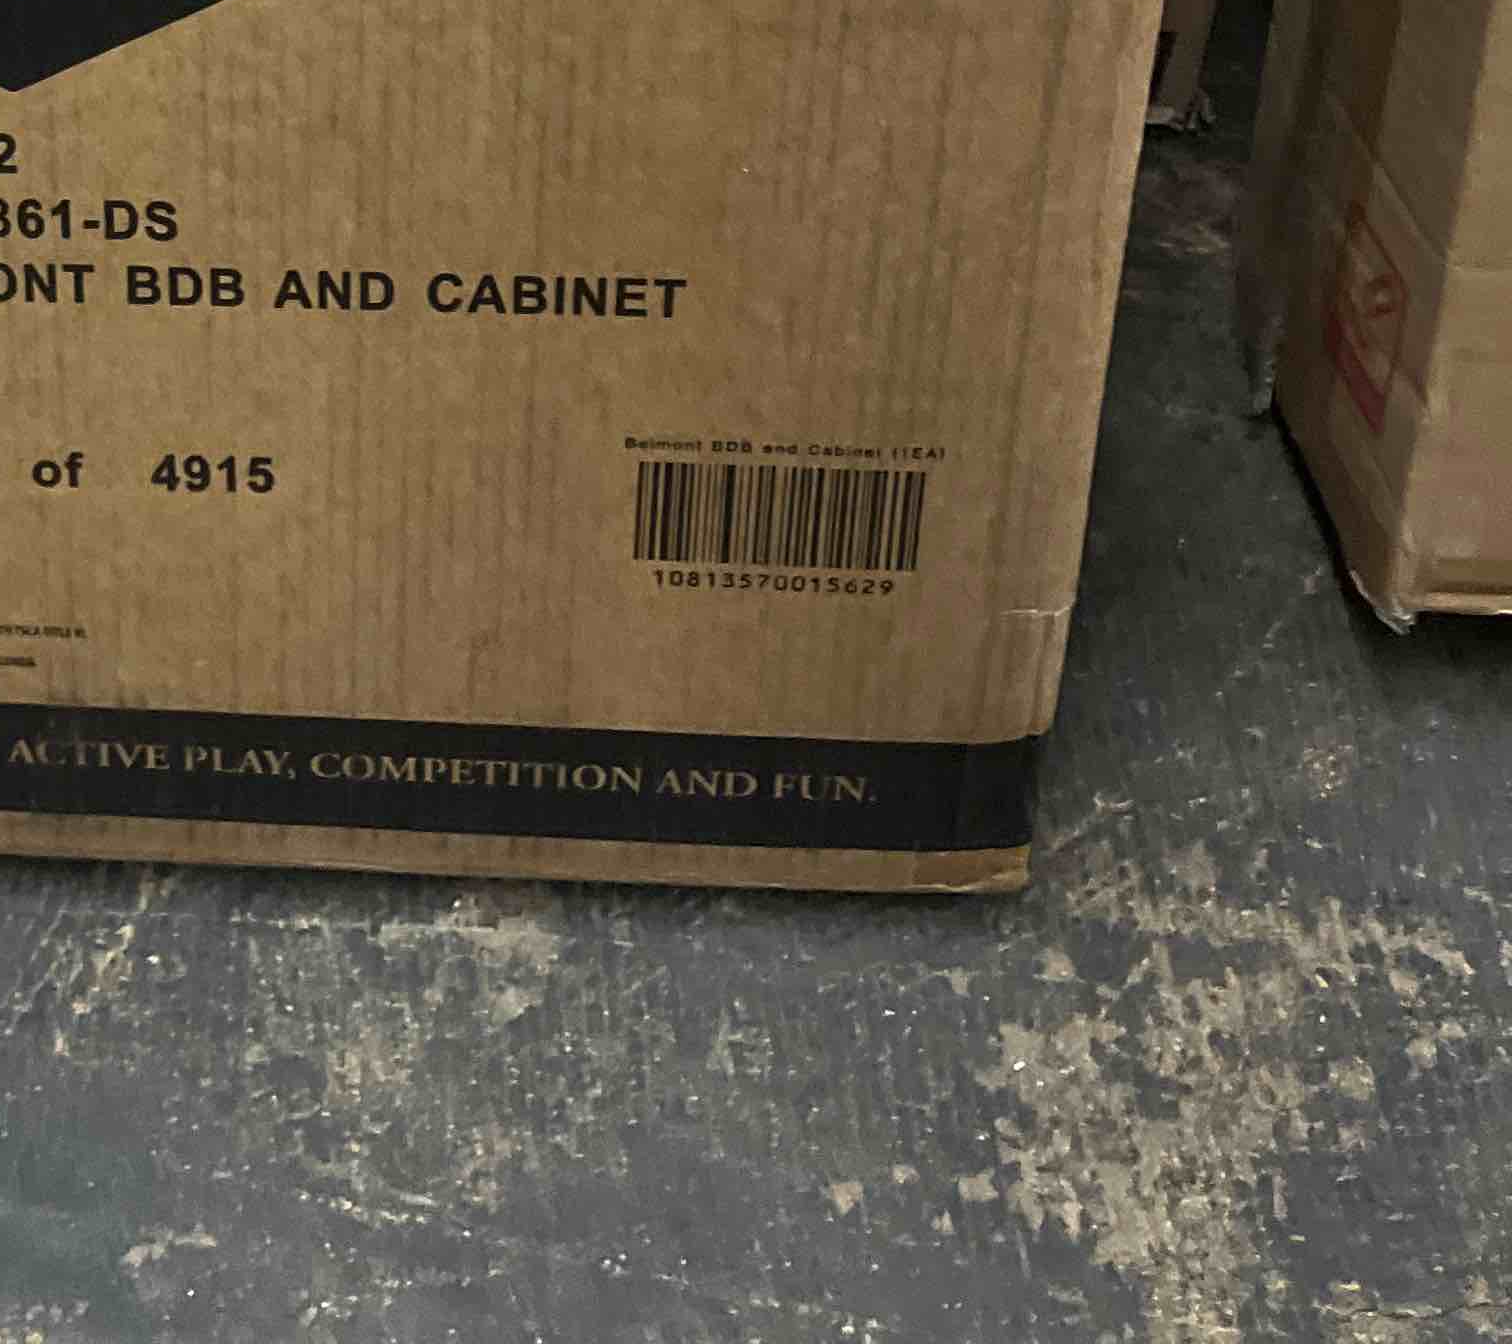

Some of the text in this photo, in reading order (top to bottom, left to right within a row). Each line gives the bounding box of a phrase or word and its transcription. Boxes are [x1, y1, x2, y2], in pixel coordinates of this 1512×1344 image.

[127, 266, 244, 307] BDB
[274, 270, 394, 310] AND
[428, 273, 687, 318] CABINET
[32, 452, 84, 488] of
[151, 454, 274, 493] 4915
[9, 736, 170, 772] ACTIVE
[182, 746, 297, 781] PLAY,
[310, 751, 643, 797] COMPETITION
[655, 768, 759, 801] AND
[772, 774, 877, 805] FUN.
